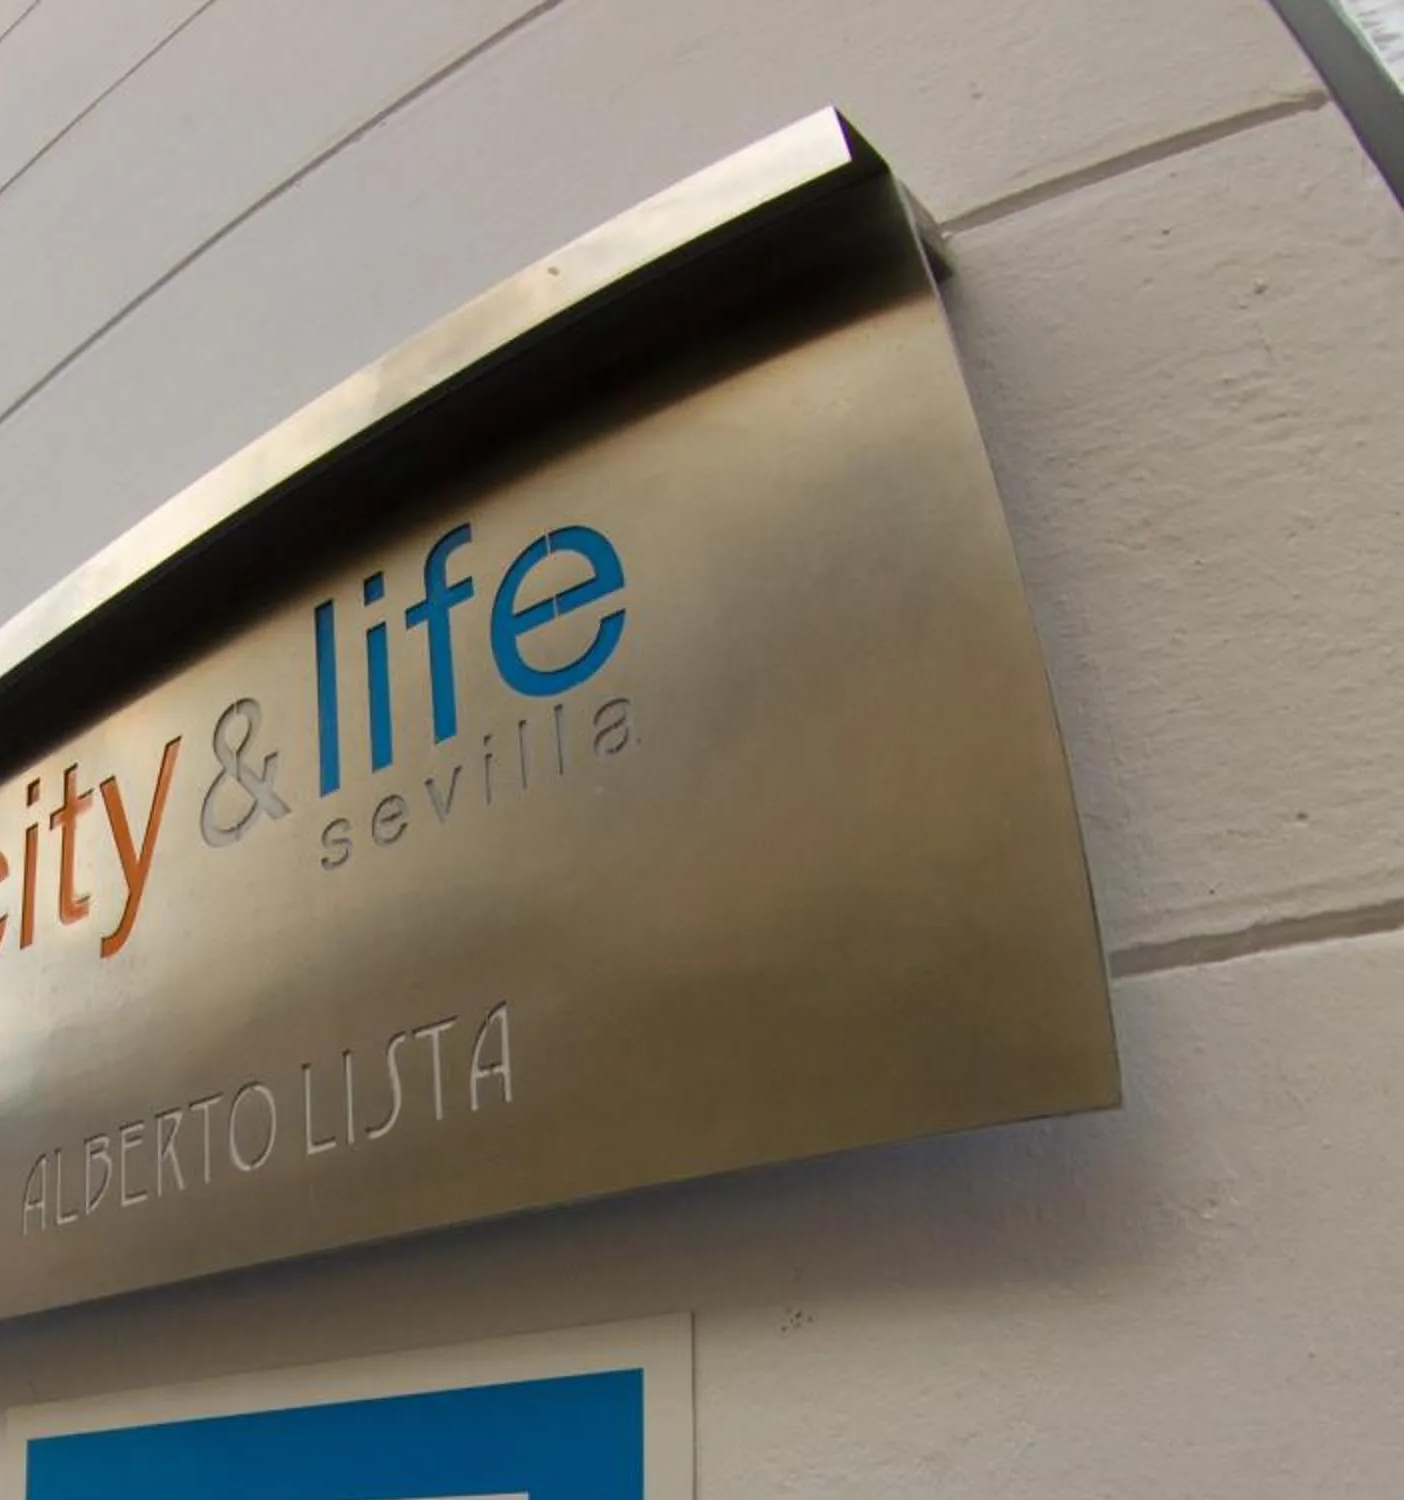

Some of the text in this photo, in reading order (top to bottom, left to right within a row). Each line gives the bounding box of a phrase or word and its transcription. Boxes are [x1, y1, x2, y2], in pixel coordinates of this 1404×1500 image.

[198, 696, 292, 848] &
[313, 521, 627, 799] life
[320, 694, 642, 871] sevilla
[21, 1000, 515, 1236] ALBERTO LISTA
